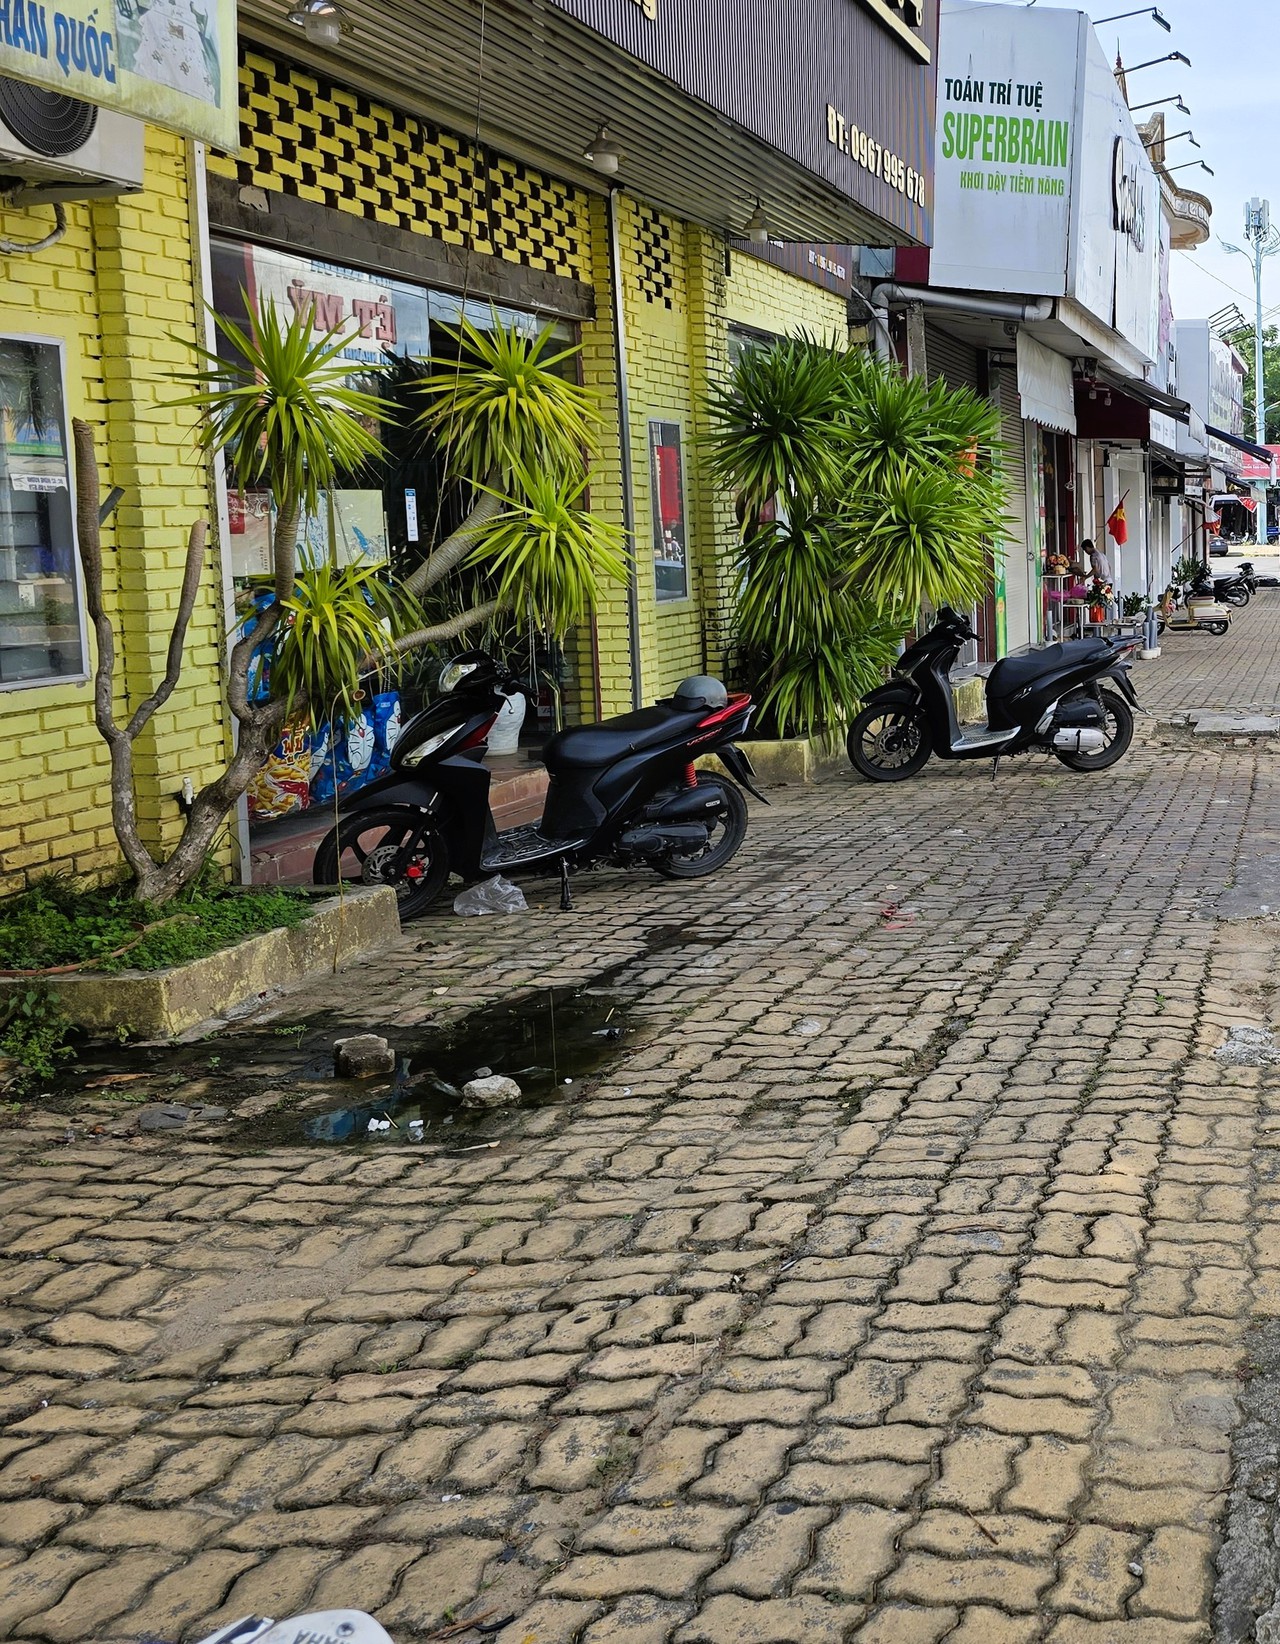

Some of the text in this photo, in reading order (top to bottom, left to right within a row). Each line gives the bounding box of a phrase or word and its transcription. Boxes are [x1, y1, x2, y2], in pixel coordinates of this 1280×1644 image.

[54, 8, 116, 84] QUỐC
[945, 75, 1043, 113] TOÁN TRÍ TUỆ
[826, 103, 925, 208] ĐT: 0967 995 678
[942, 111, 1069, 168] SUPERBRAIN
[987, 170, 1007, 195] DẬY
[1009, 169, 1034, 194] TIỀM
[1037, 175, 1065, 196] NĂNG
